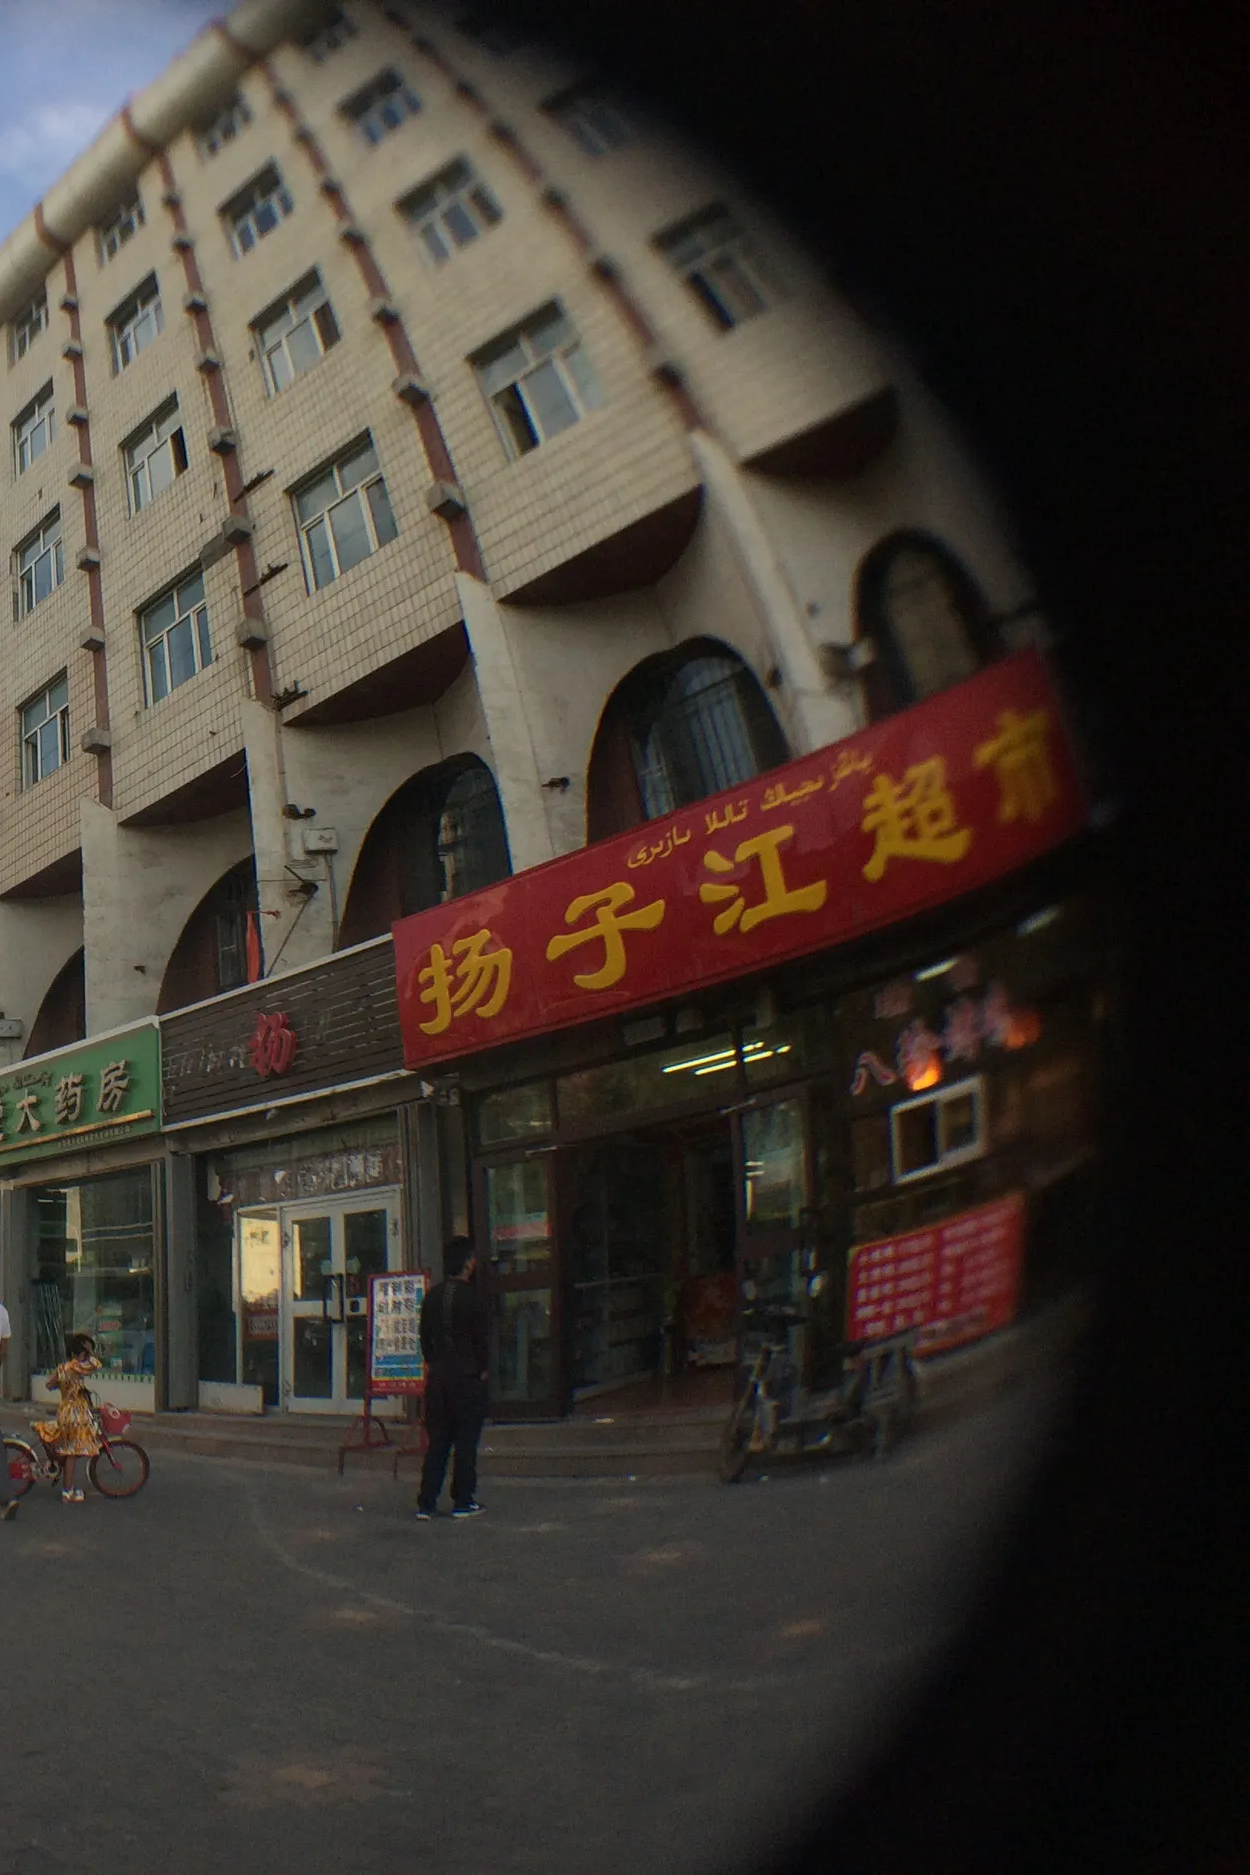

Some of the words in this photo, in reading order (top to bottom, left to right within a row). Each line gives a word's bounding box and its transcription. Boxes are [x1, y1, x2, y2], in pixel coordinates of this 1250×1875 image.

[417, 703, 1053, 1036] 扬子江超市
